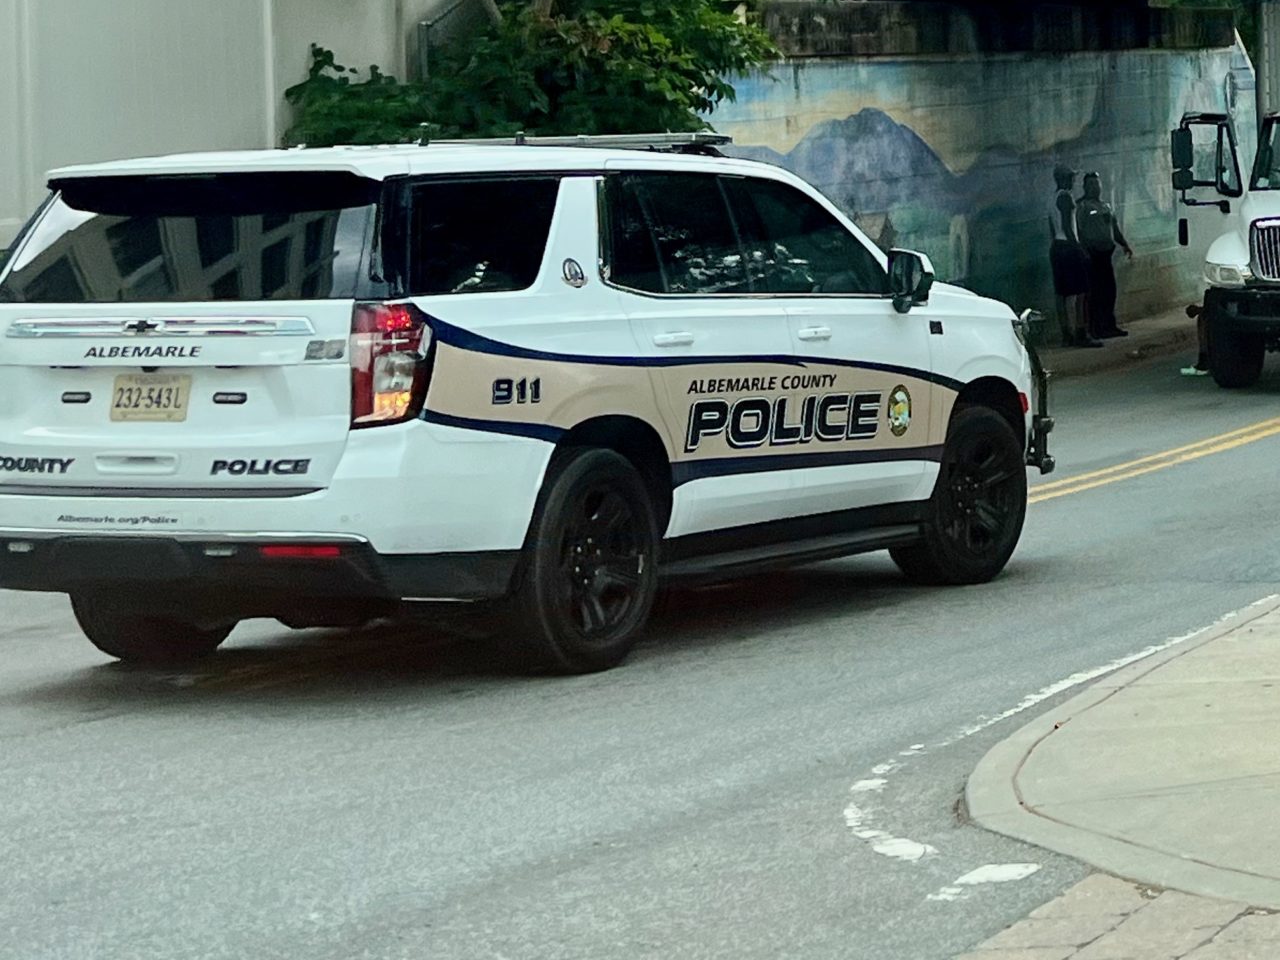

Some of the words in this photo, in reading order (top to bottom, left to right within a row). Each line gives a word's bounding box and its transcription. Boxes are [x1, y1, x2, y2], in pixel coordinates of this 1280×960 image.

[84, 345, 202, 358] ALBEMARLE
[491, 377, 541, 404] 911
[687, 375, 777, 395] ALBEMARLE
[781, 374, 837, 390] COUNTY
[684, 390, 883, 454] POLICE
[210, 458, 311, 476] POLICE
